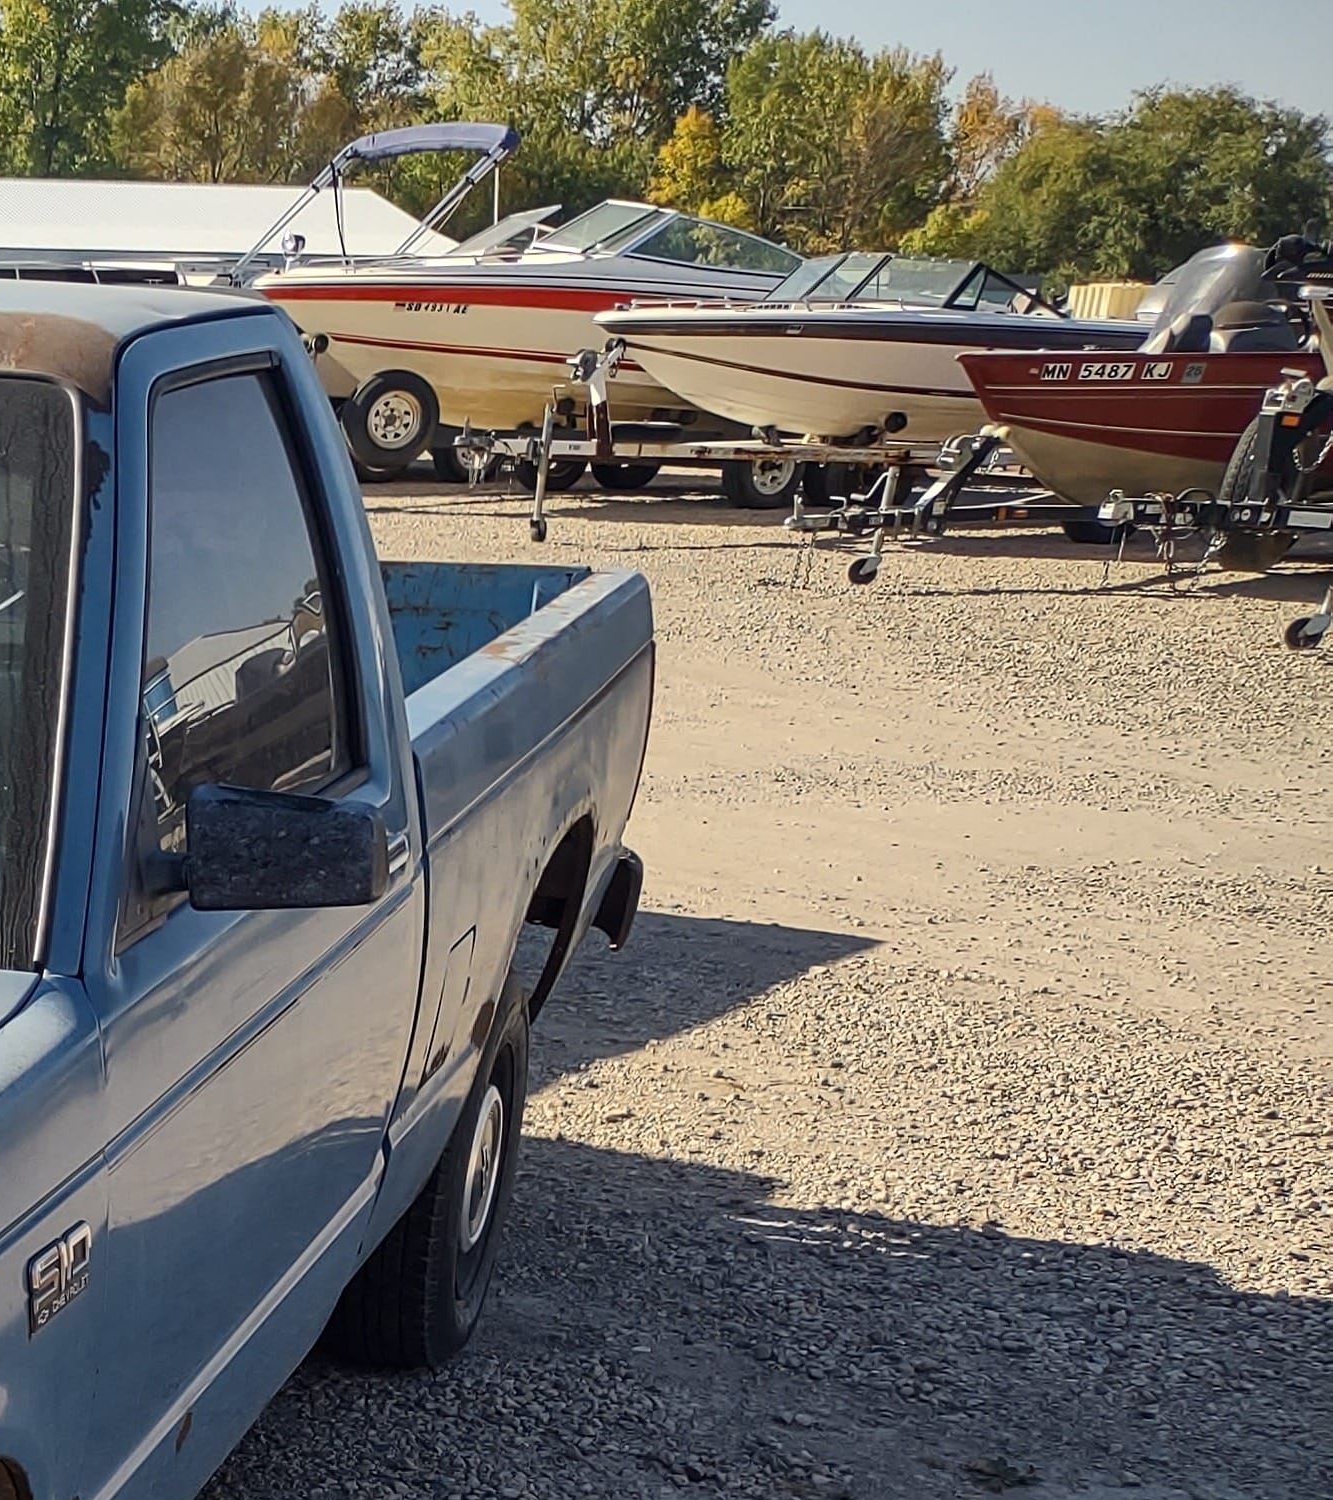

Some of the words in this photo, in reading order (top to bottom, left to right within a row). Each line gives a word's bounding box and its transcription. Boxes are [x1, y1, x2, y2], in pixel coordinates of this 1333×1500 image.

[1041, 364, 1070, 379] MN
[1080, 363, 1134, 379] 5487
[1143, 363, 1171, 379] KJ
